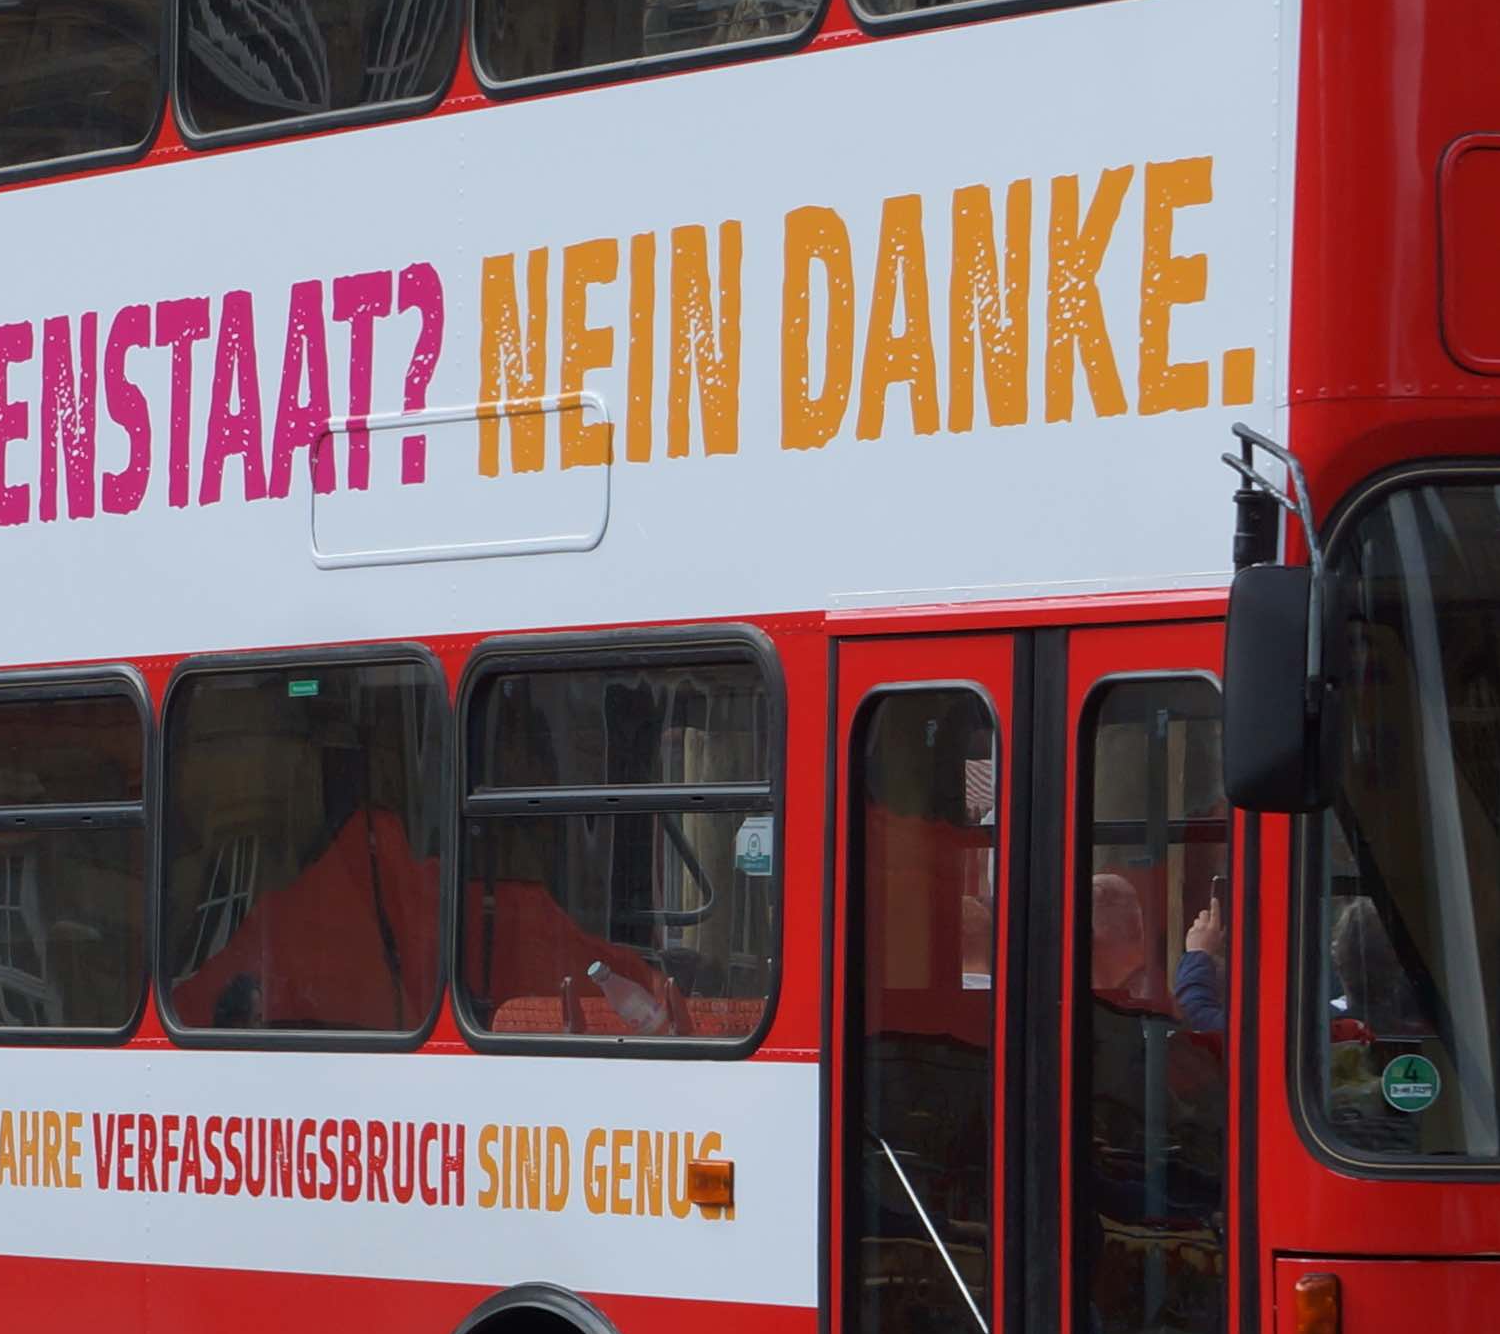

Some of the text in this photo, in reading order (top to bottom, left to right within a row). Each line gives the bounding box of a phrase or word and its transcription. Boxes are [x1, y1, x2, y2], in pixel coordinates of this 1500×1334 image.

[476, 219, 742, 478] NEIN
[780, 155, 1255, 452] DANKE.
[91, 1111, 467, 1208] VERFASSUNGSBRUCH
[477, 1128, 571, 1215] SIND
